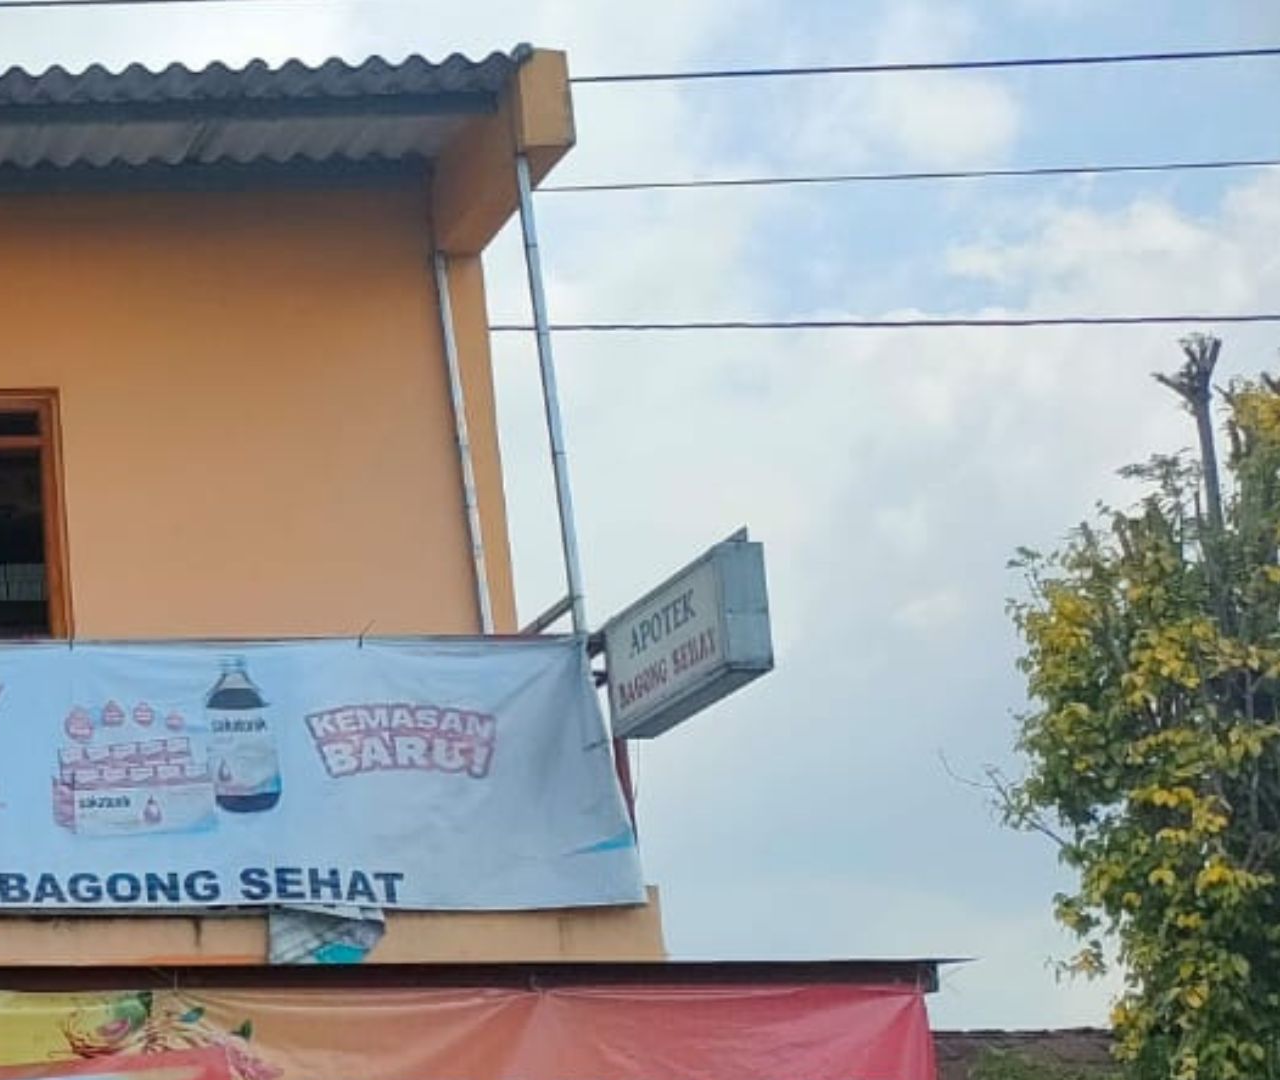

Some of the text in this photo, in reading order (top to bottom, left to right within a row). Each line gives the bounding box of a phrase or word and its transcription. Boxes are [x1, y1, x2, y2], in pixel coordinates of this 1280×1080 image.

[629, 588, 696, 660] APOTEK
[619, 657, 668, 710] BAGONG
[306, 704, 496, 738] KEMASAN
[320, 735, 492, 777] BARU!
[240, 867, 406, 905] SEHAT
